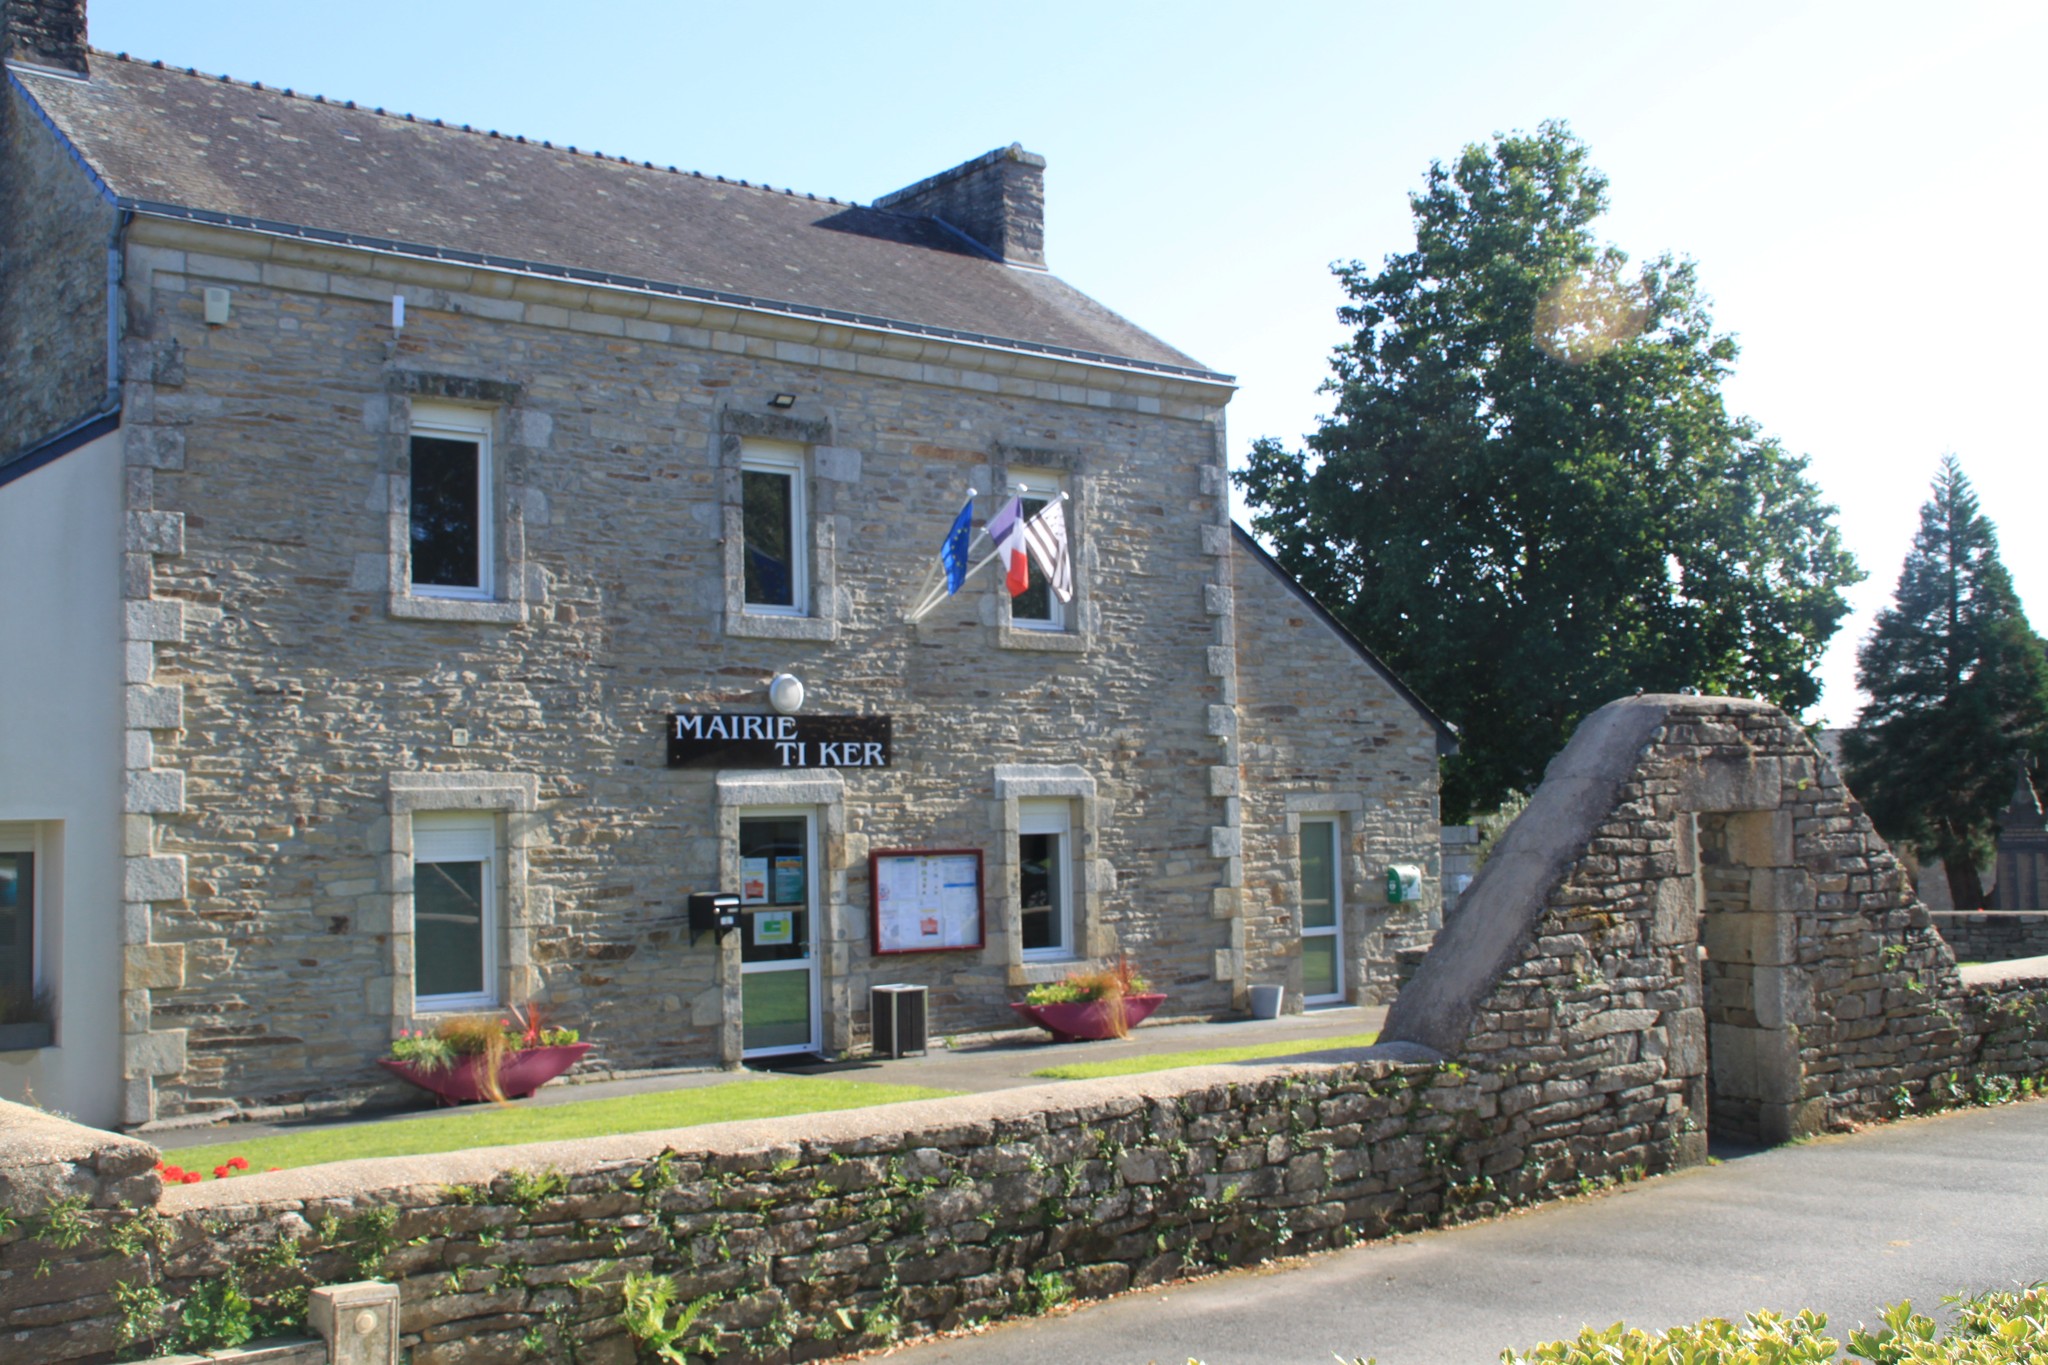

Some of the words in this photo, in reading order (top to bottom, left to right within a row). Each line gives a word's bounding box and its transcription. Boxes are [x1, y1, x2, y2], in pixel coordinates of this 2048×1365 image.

[676, 715, 798, 740] MAIRIE
[774, 742, 806, 766] TI
[819, 742, 885, 766] KER
